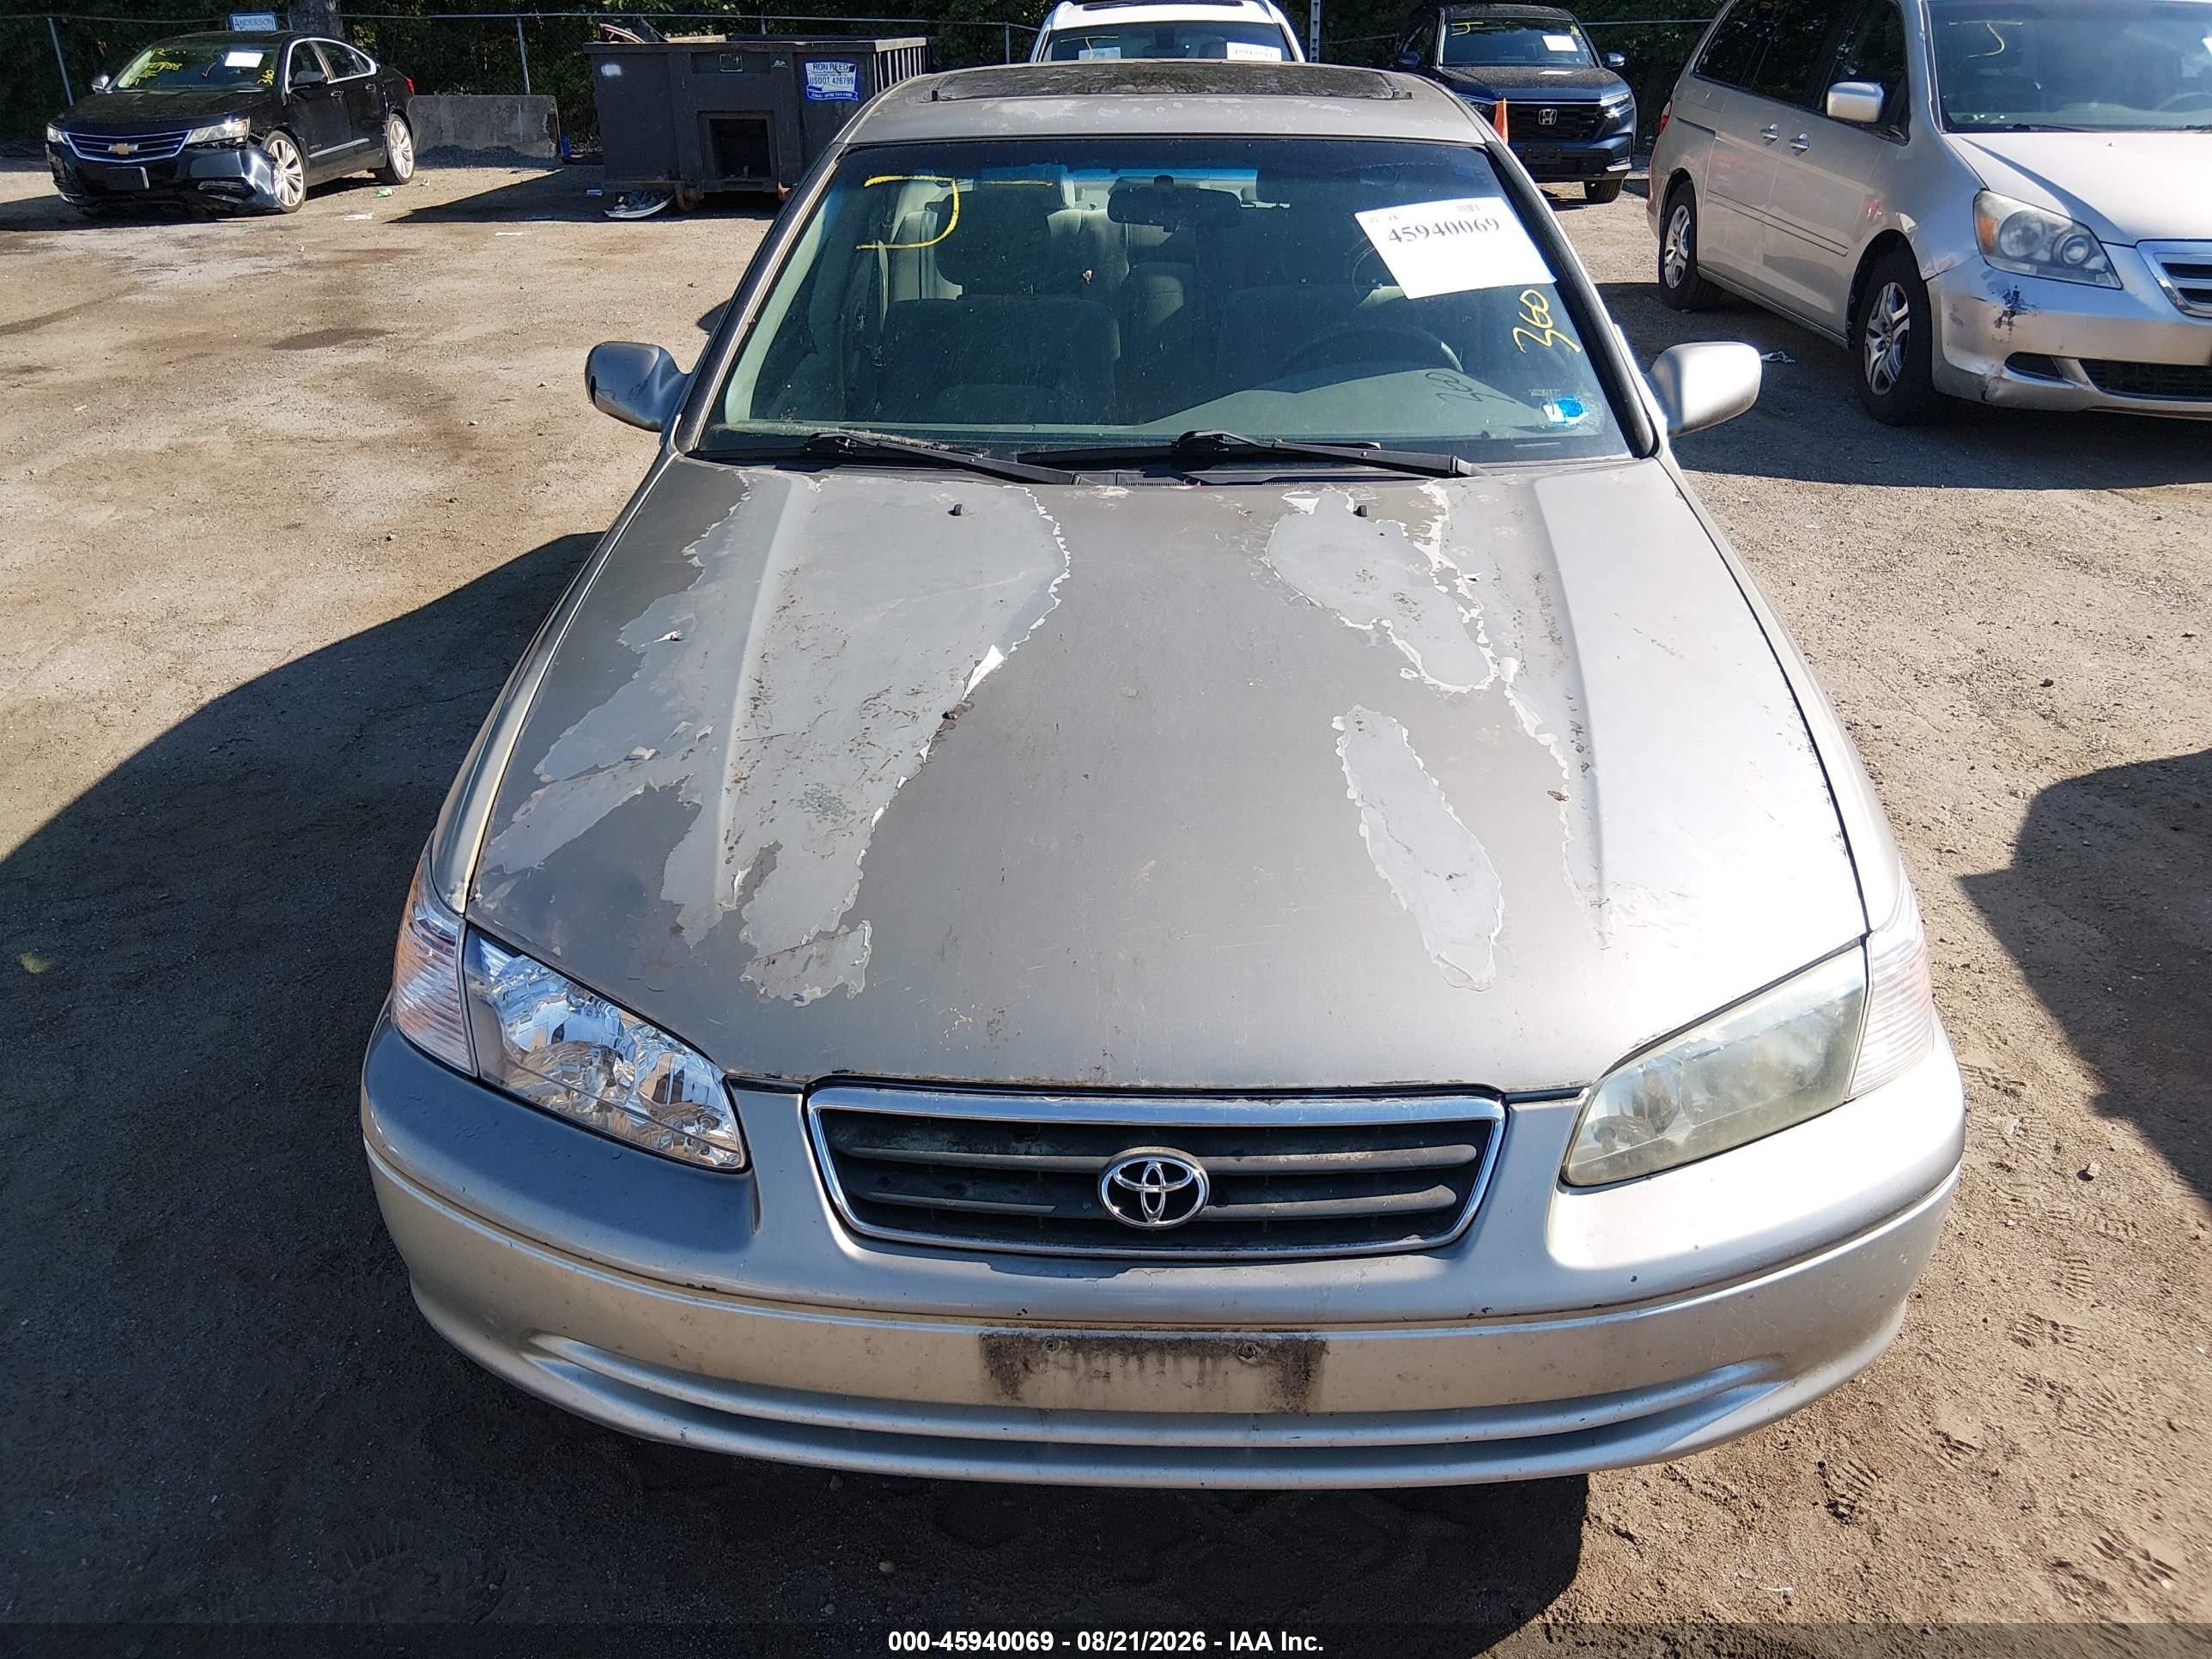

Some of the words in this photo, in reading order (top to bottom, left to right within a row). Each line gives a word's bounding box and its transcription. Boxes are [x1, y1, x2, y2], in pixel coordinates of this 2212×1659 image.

[812, 63, 828, 71] RON
[829, 63, 849, 71] REED
[810, 76, 830, 85] USDOT
[1388, 216, 1500, 243] 45940069
[1511, 288, 1582, 355] 360
